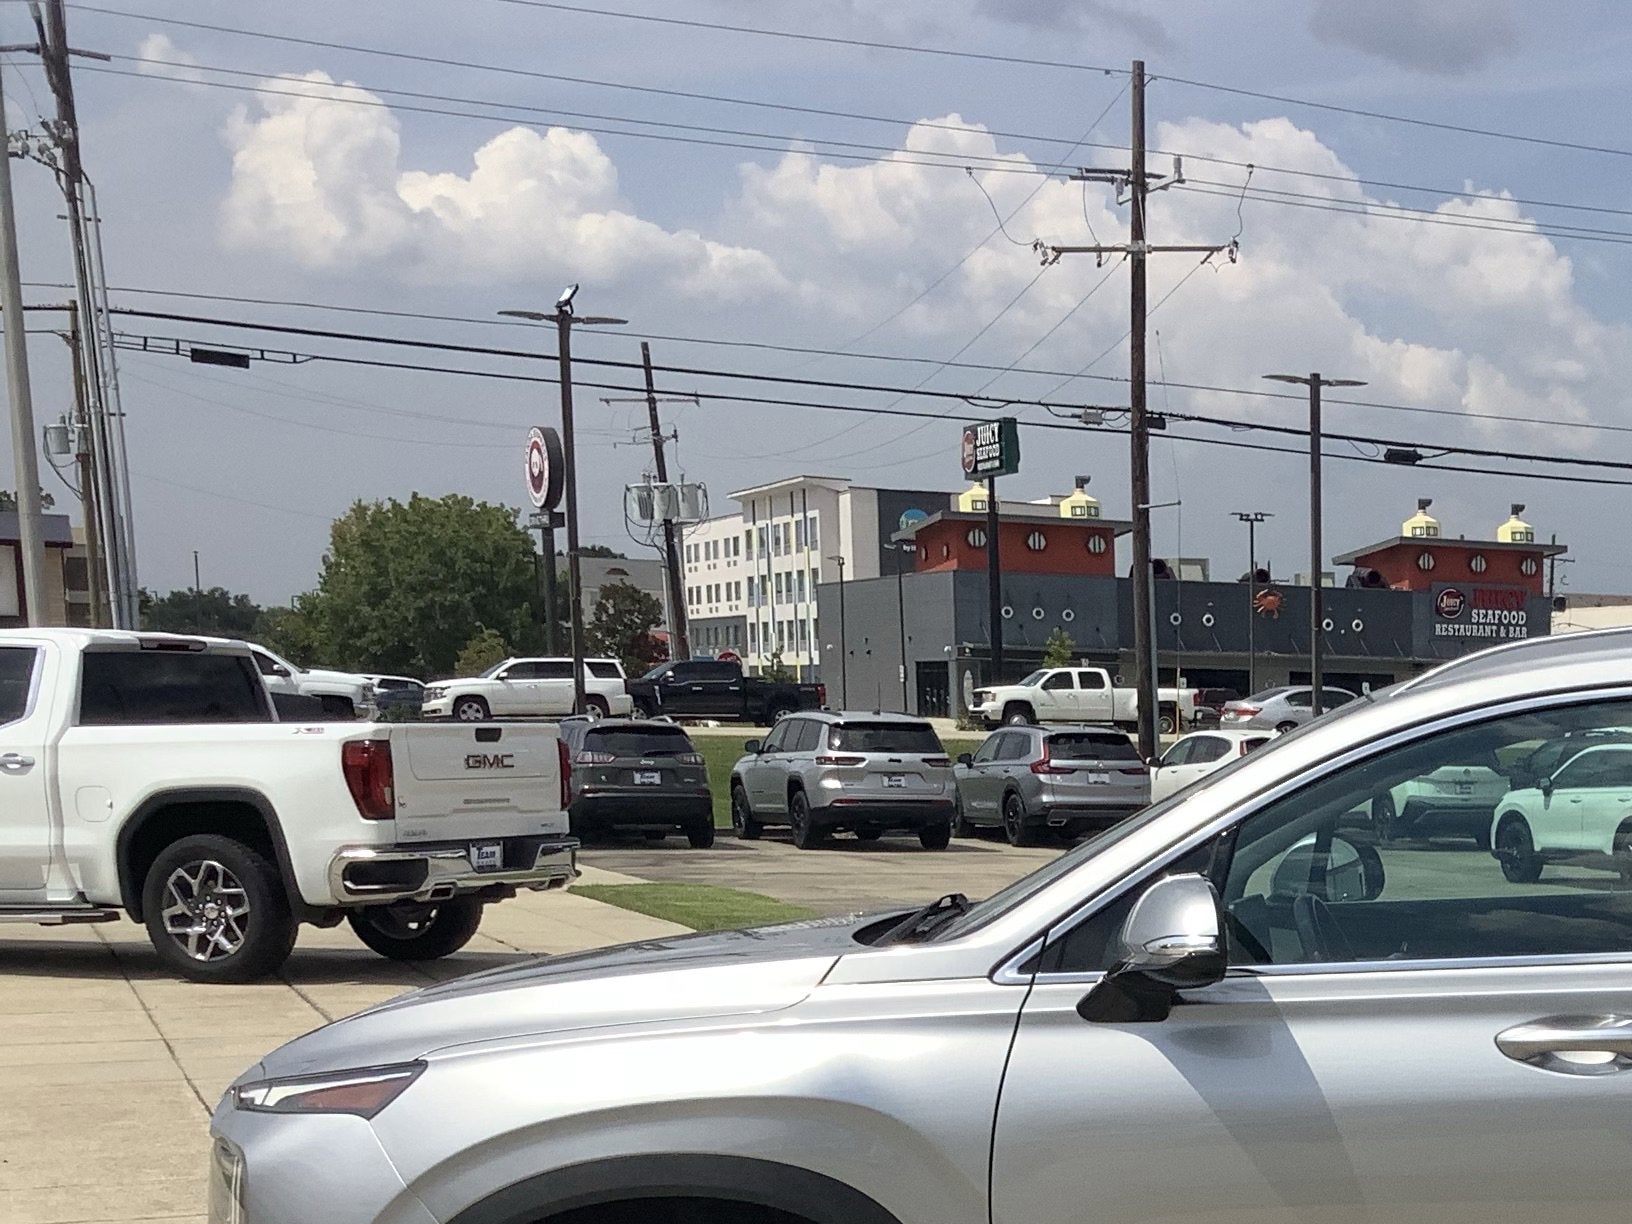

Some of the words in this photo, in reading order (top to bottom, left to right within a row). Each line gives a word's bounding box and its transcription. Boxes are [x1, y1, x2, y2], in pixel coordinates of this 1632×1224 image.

[976, 422, 999, 447] JUICY
[1471, 609, 1527, 624] SEAFOOD
[1435, 624, 1498, 637] RESTAURANT
[1500, 626, 1506, 638] &
[1508, 626, 1528, 638] BAR
[465, 754, 515, 769] GMC
